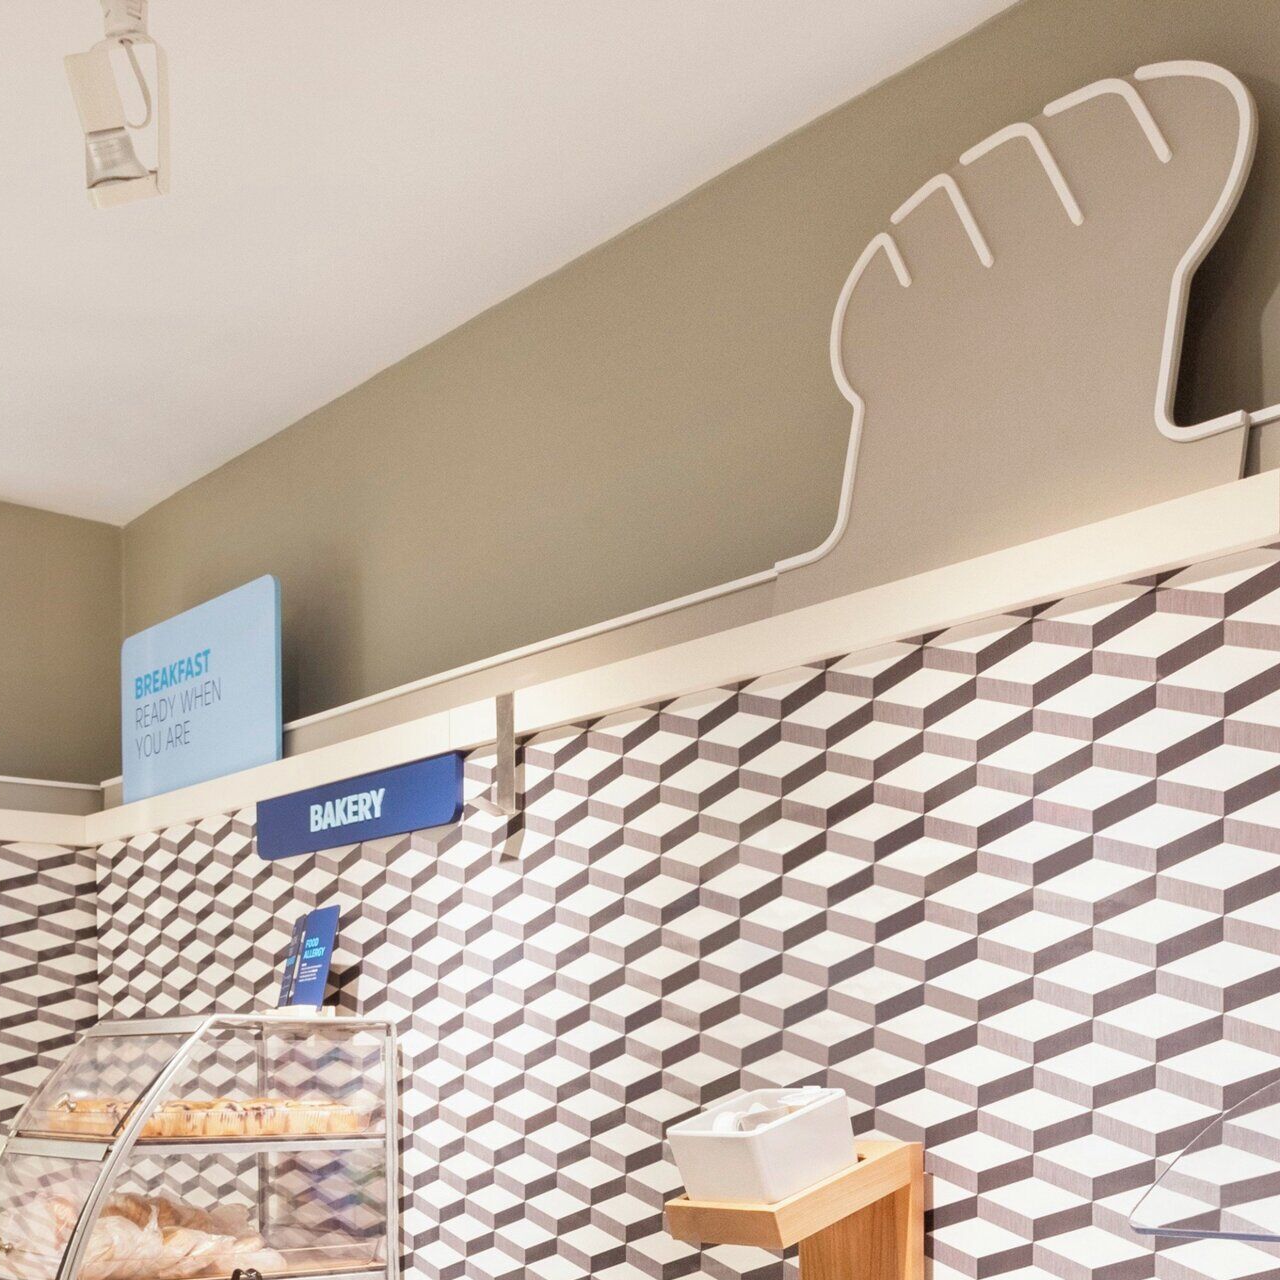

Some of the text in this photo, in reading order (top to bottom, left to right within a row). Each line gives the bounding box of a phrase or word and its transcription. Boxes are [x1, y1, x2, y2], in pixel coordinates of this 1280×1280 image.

[135, 648, 211, 700] BREAKFAST
[135, 676, 222, 731] READY WHEN
[135, 720, 191, 761] YOU ARE
[309, 787, 386, 833] BAKERY
[303, 946, 326, 960] ALLERGY
[305, 937, 320, 949] FOOD
